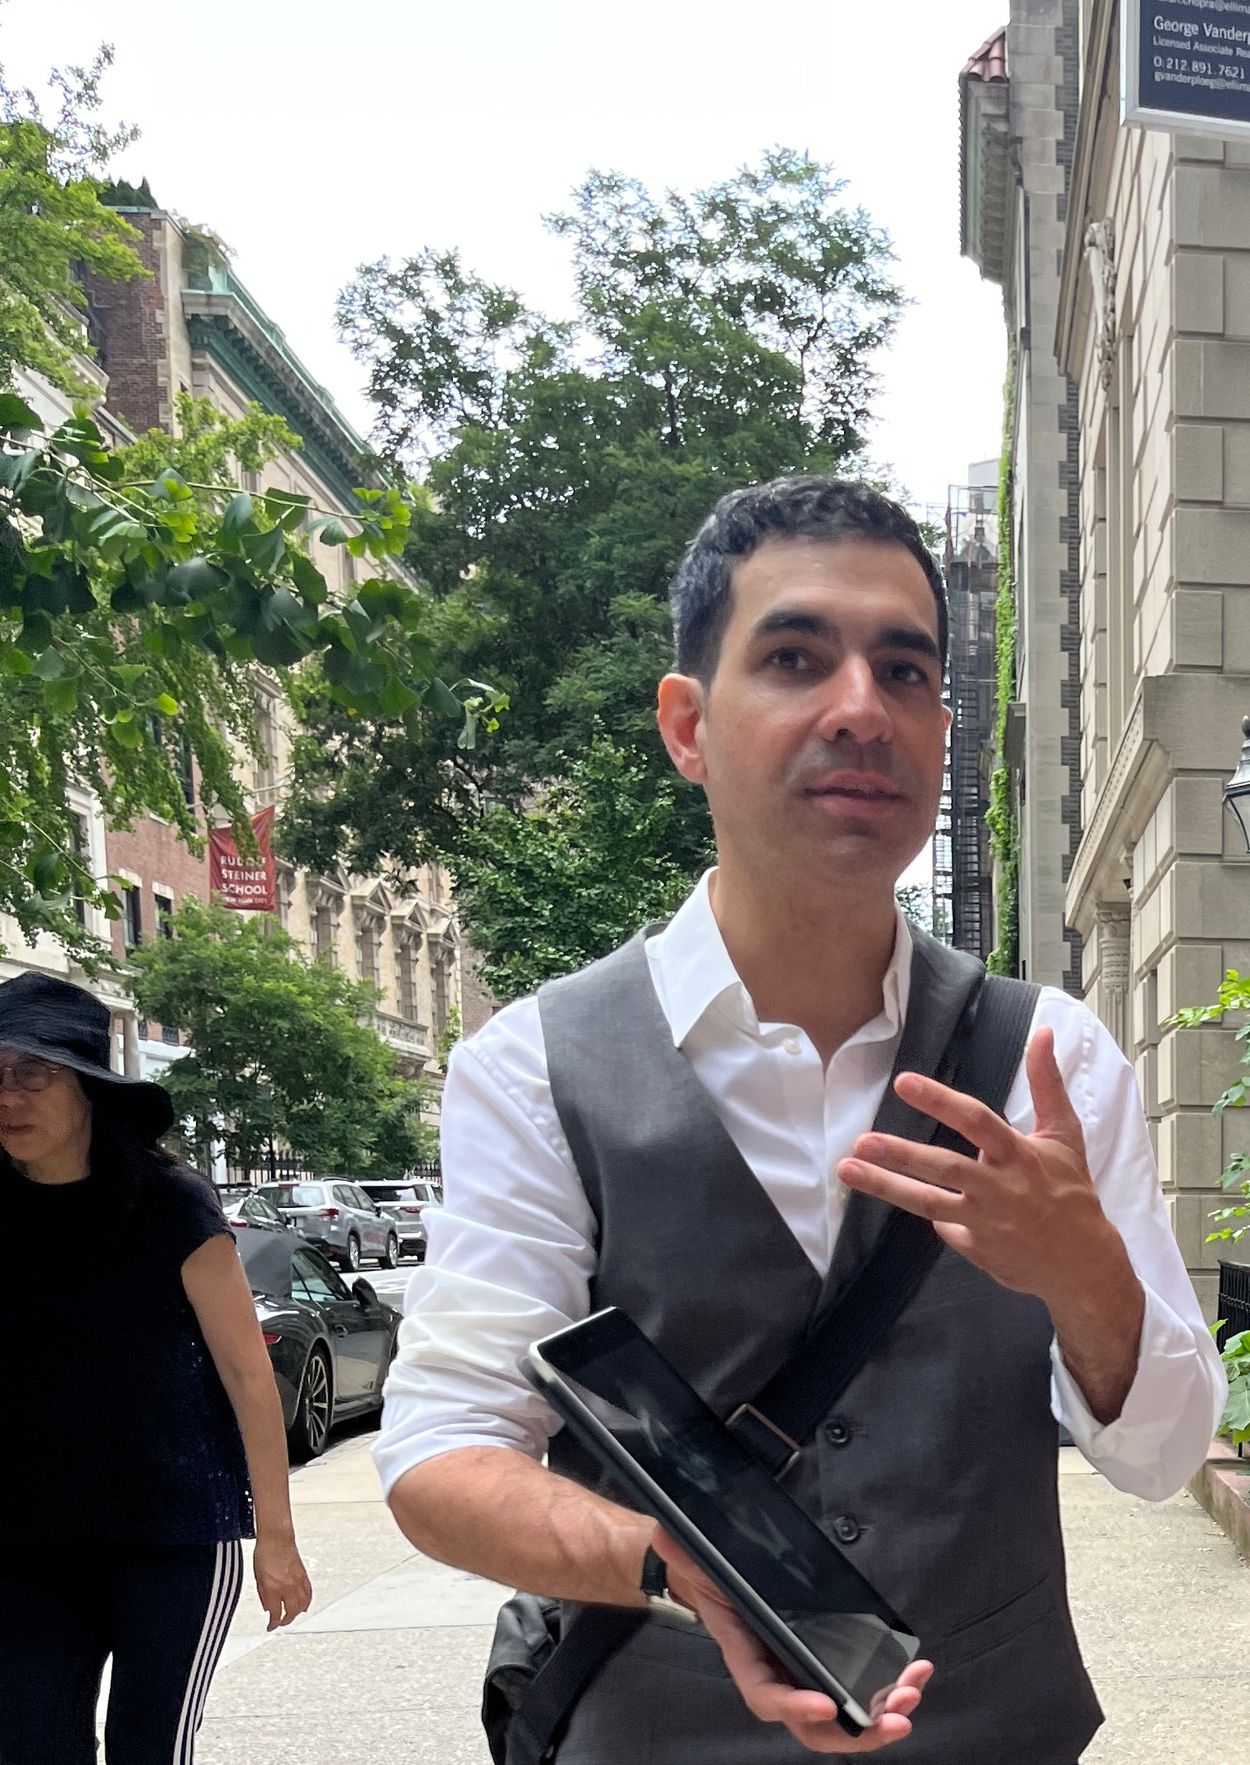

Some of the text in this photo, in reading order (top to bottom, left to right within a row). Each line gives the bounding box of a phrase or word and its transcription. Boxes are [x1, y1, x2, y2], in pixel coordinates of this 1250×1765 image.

[1154, 16, 1199, 37] George
[1153, 35, 1191, 50] Licensed
[221, 868, 267, 881] STEINER
[222, 883, 268, 895] SCHOOL
